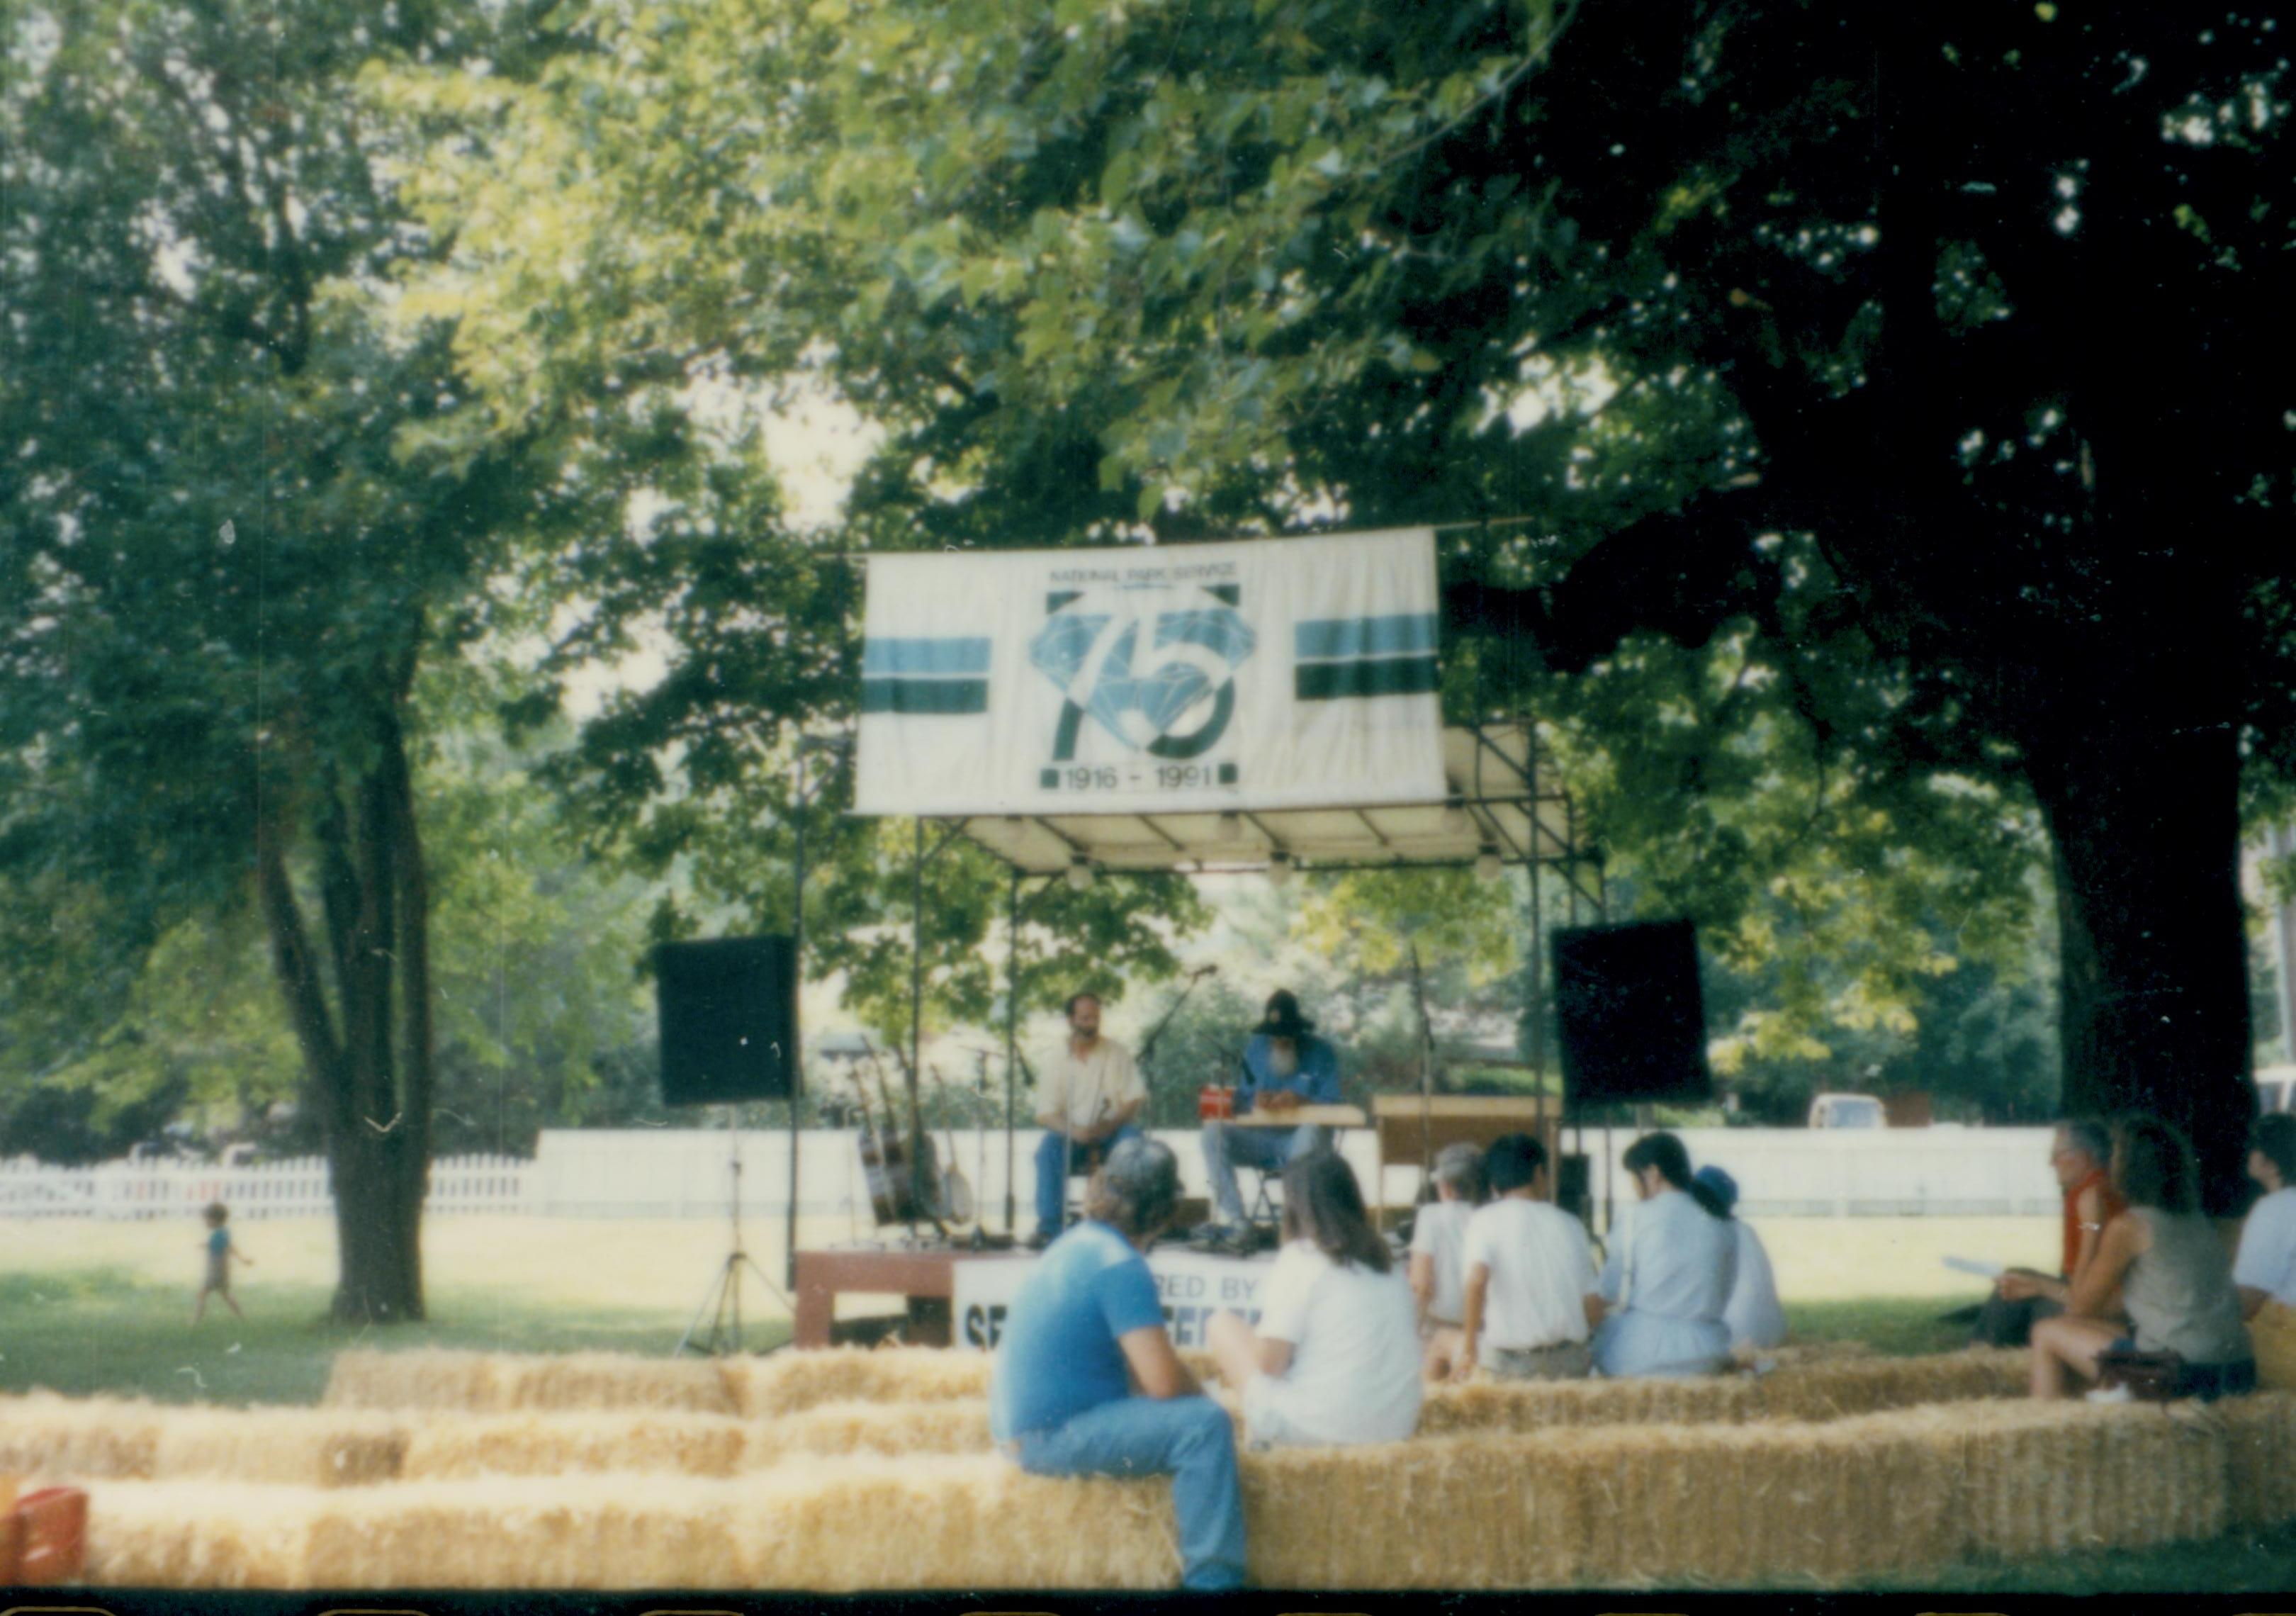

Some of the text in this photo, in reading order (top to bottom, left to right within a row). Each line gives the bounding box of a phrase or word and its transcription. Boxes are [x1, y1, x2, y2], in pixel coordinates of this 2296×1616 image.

[1046, 587, 1240, 762] 75
[1067, 767, 1118, 789] 1916
[1155, 765, 1211, 787] 1991
[1221, 1276, 1260, 1300] BY
